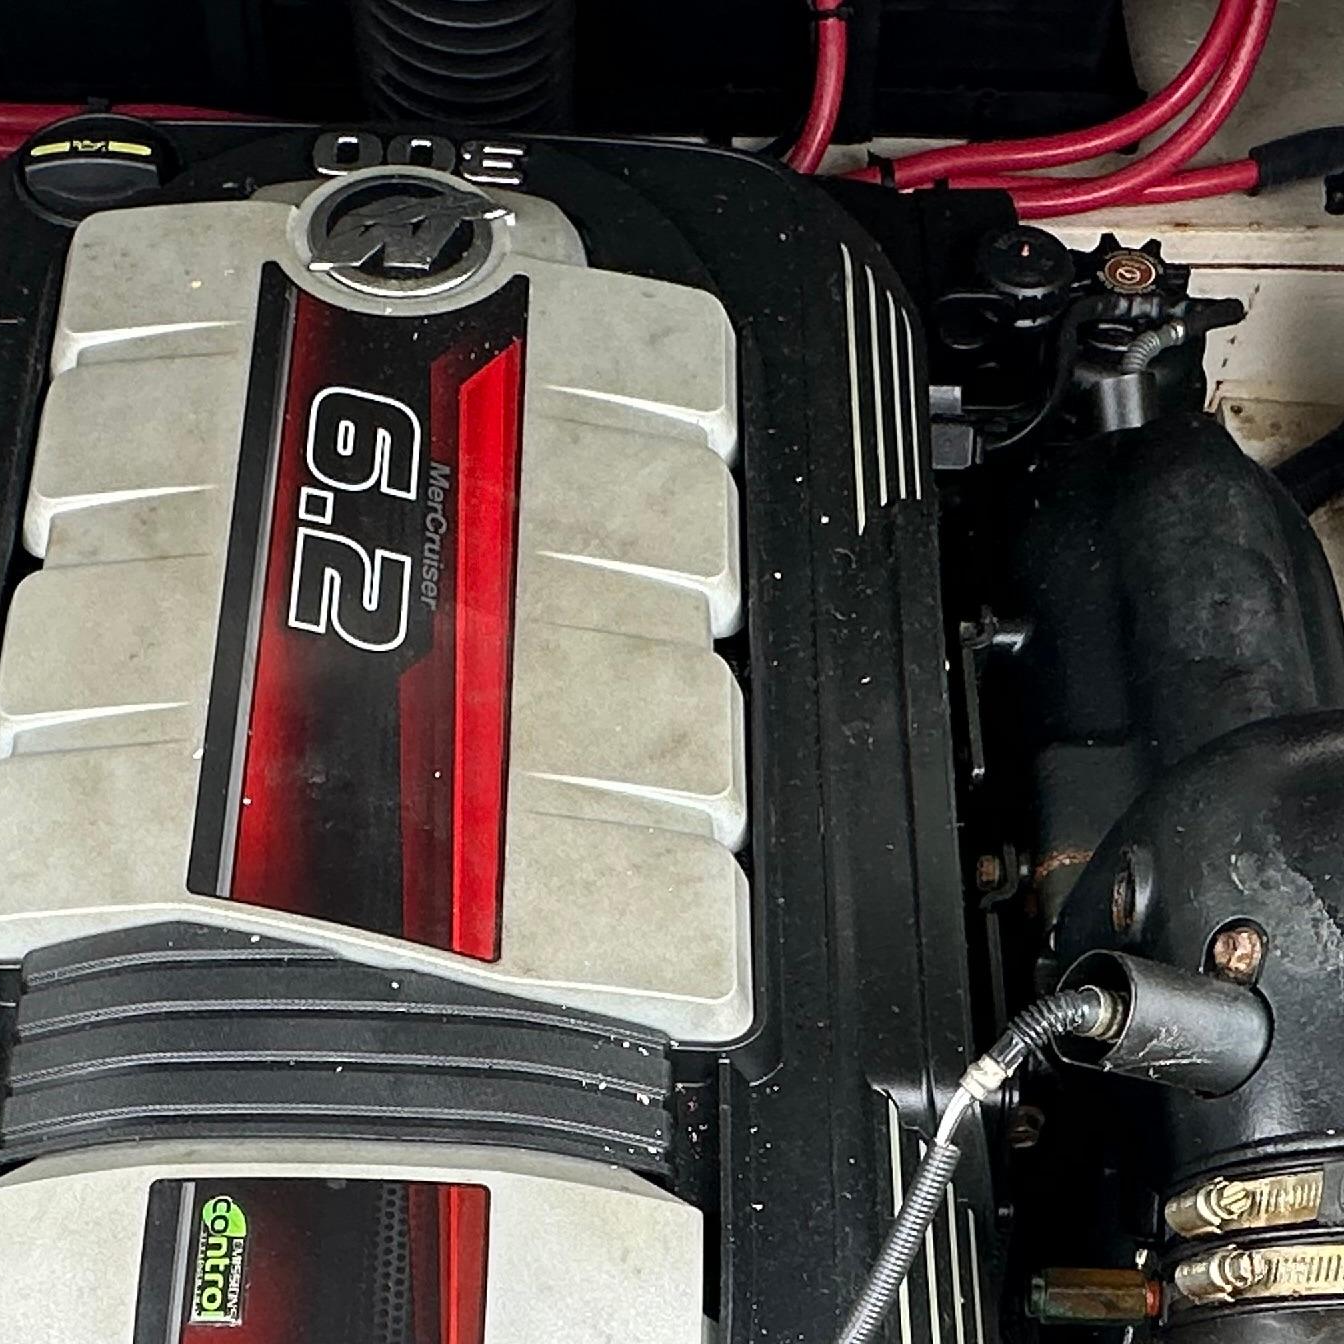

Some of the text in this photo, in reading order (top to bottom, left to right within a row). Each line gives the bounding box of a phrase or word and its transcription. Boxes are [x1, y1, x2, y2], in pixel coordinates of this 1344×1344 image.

[312, 131, 529, 186] 300
[288, 386, 422, 652] 6.2
[420, 461, 451, 611] MerCruiser
[200, 1198, 232, 1318] control
